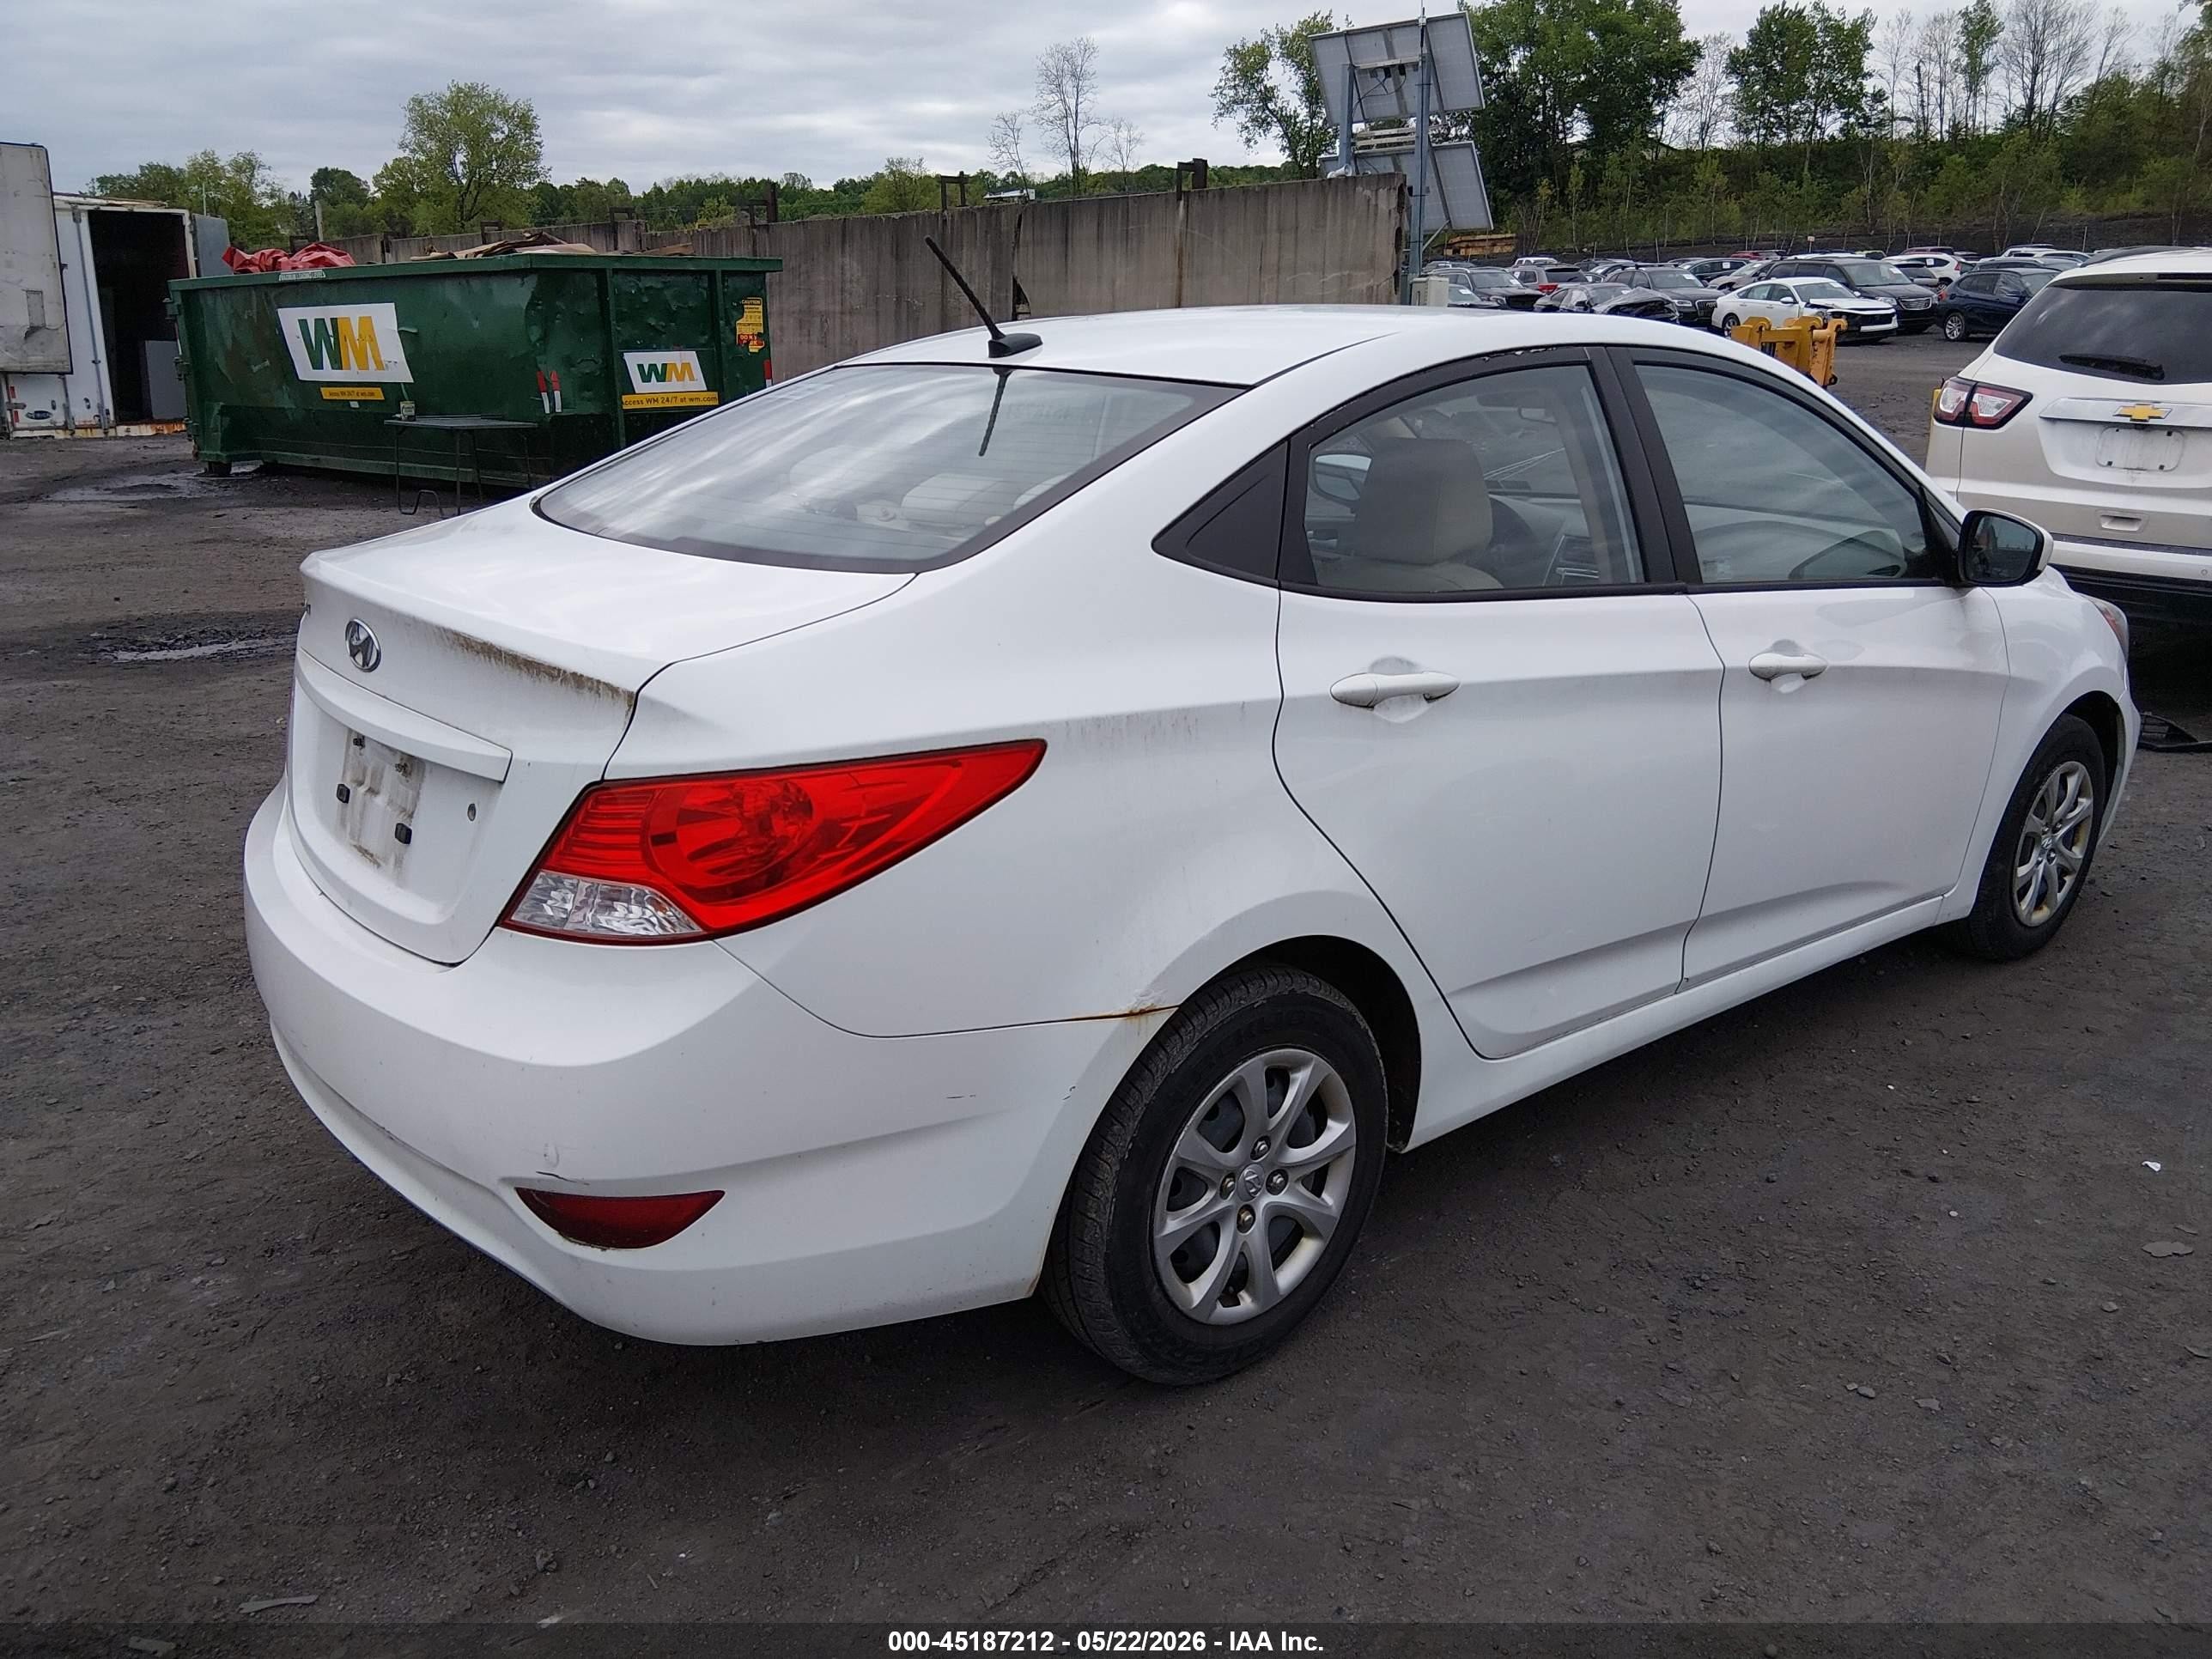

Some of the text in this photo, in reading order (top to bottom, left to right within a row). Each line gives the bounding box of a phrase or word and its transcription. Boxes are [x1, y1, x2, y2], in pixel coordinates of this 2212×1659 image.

[297, 315, 386, 371] WM
[636, 362, 695, 383] WM
[660, 396, 678, 404] 24/7
